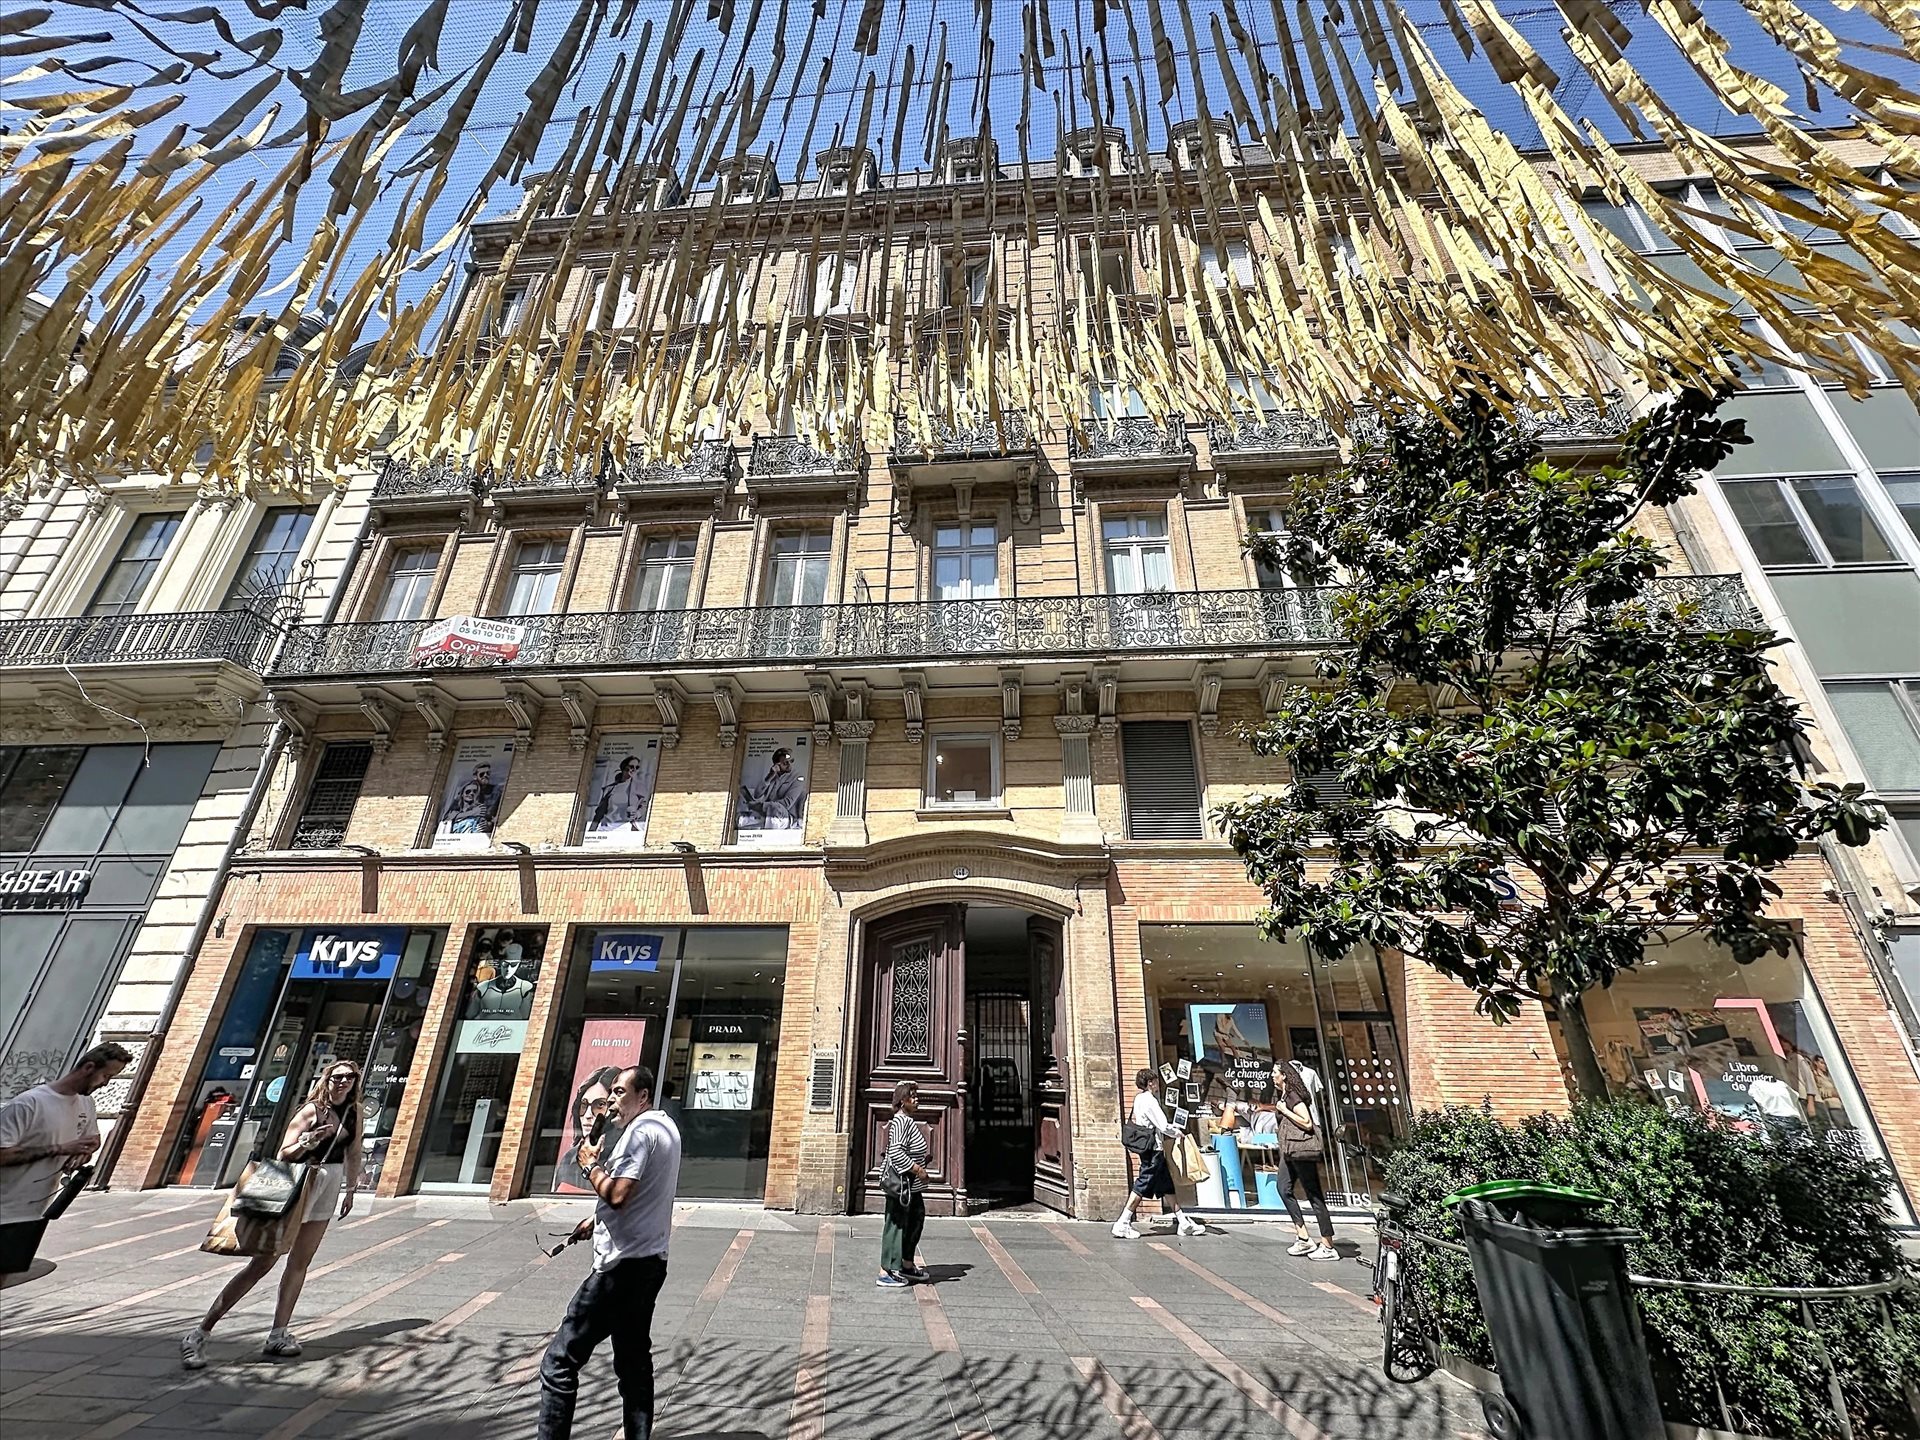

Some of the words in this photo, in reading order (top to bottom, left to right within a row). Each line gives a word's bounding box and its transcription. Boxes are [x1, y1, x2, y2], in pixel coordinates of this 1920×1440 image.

[458, 626, 471, 634] 05
[472, 628, 481, 636] 61
[483, 629, 493, 637] 10
[495, 631, 505, 639] 01
[507, 633, 516, 641] 19
[473, 620, 517, 635] VENDRE
[450, 639, 481, 653] Orpi
[0, 869, 91, 893] &BEAR
[308, 935, 381, 968] Krys
[600, 940, 652, 965] Krys
[708, 1025, 743, 1034] PRADA
[372, 1064, 388, 1072] Voir
[389, 1064, 398, 1072] la
[1233, 1058, 1260, 1069] Libre
[1728, 1062, 1759, 1072] Libre
[386, 1075, 398, 1083] vie
[1224, 1068, 1236, 1078] de
[1237, 1068, 1271, 1081] changer
[1722, 1072, 1734, 1082] de
[1231, 1078, 1245, 1088] de
[1247, 1080, 1267, 1091] cap
[1731, 1081, 1747, 1092] de
[1342, 1192, 1372, 1207] TBS
